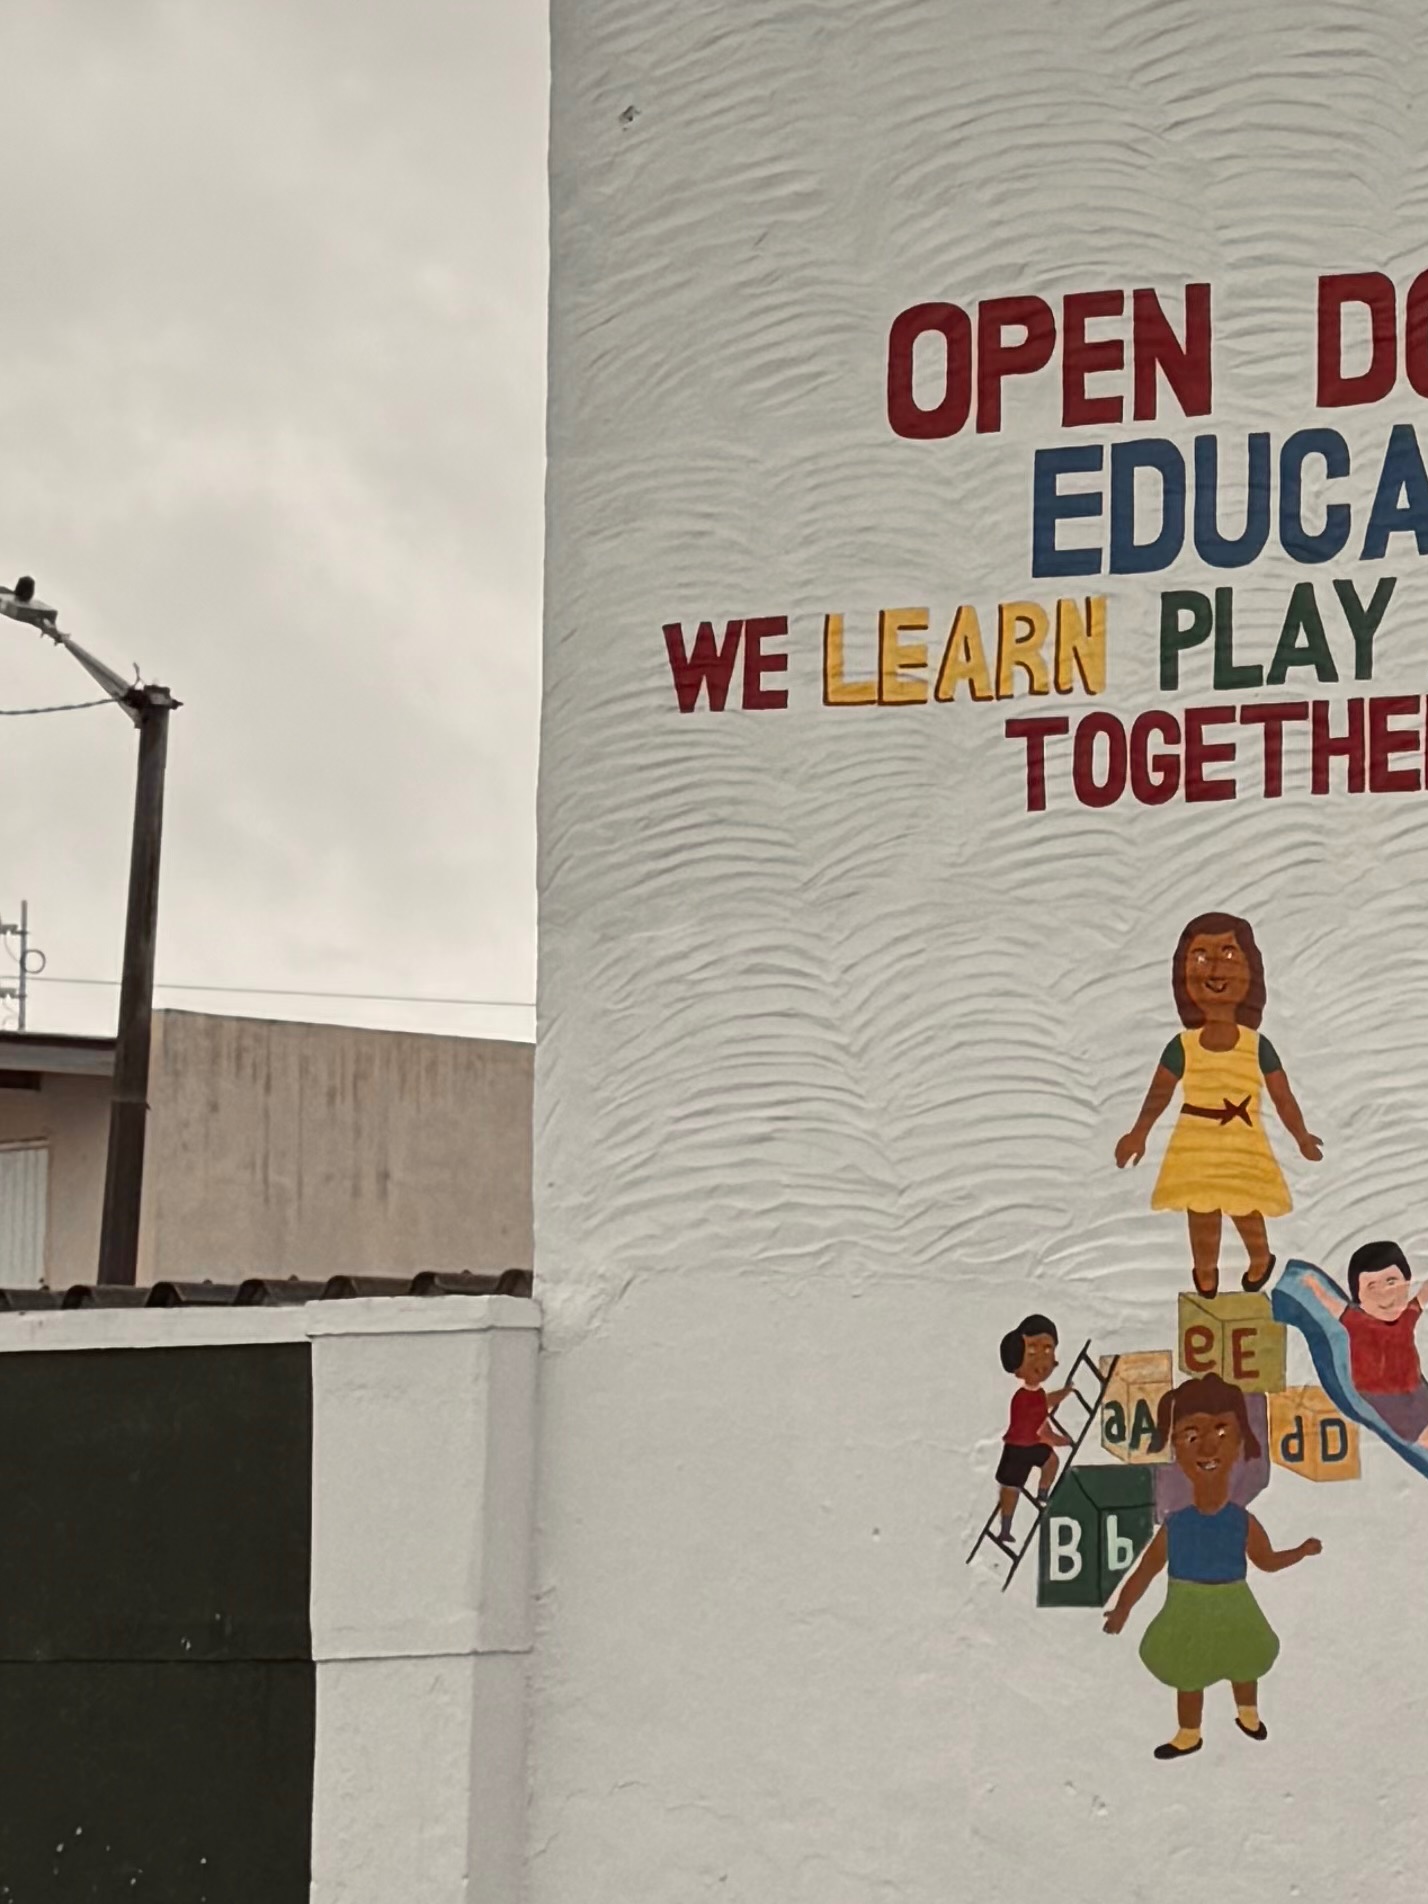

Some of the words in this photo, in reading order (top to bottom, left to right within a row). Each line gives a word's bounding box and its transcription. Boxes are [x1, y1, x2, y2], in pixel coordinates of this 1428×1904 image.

[886, 282, 1213, 441] OPEN
[661, 614, 789, 714] WE
[822, 595, 1107, 708] LEARN
[1159, 576, 1398, 692] PLAY
